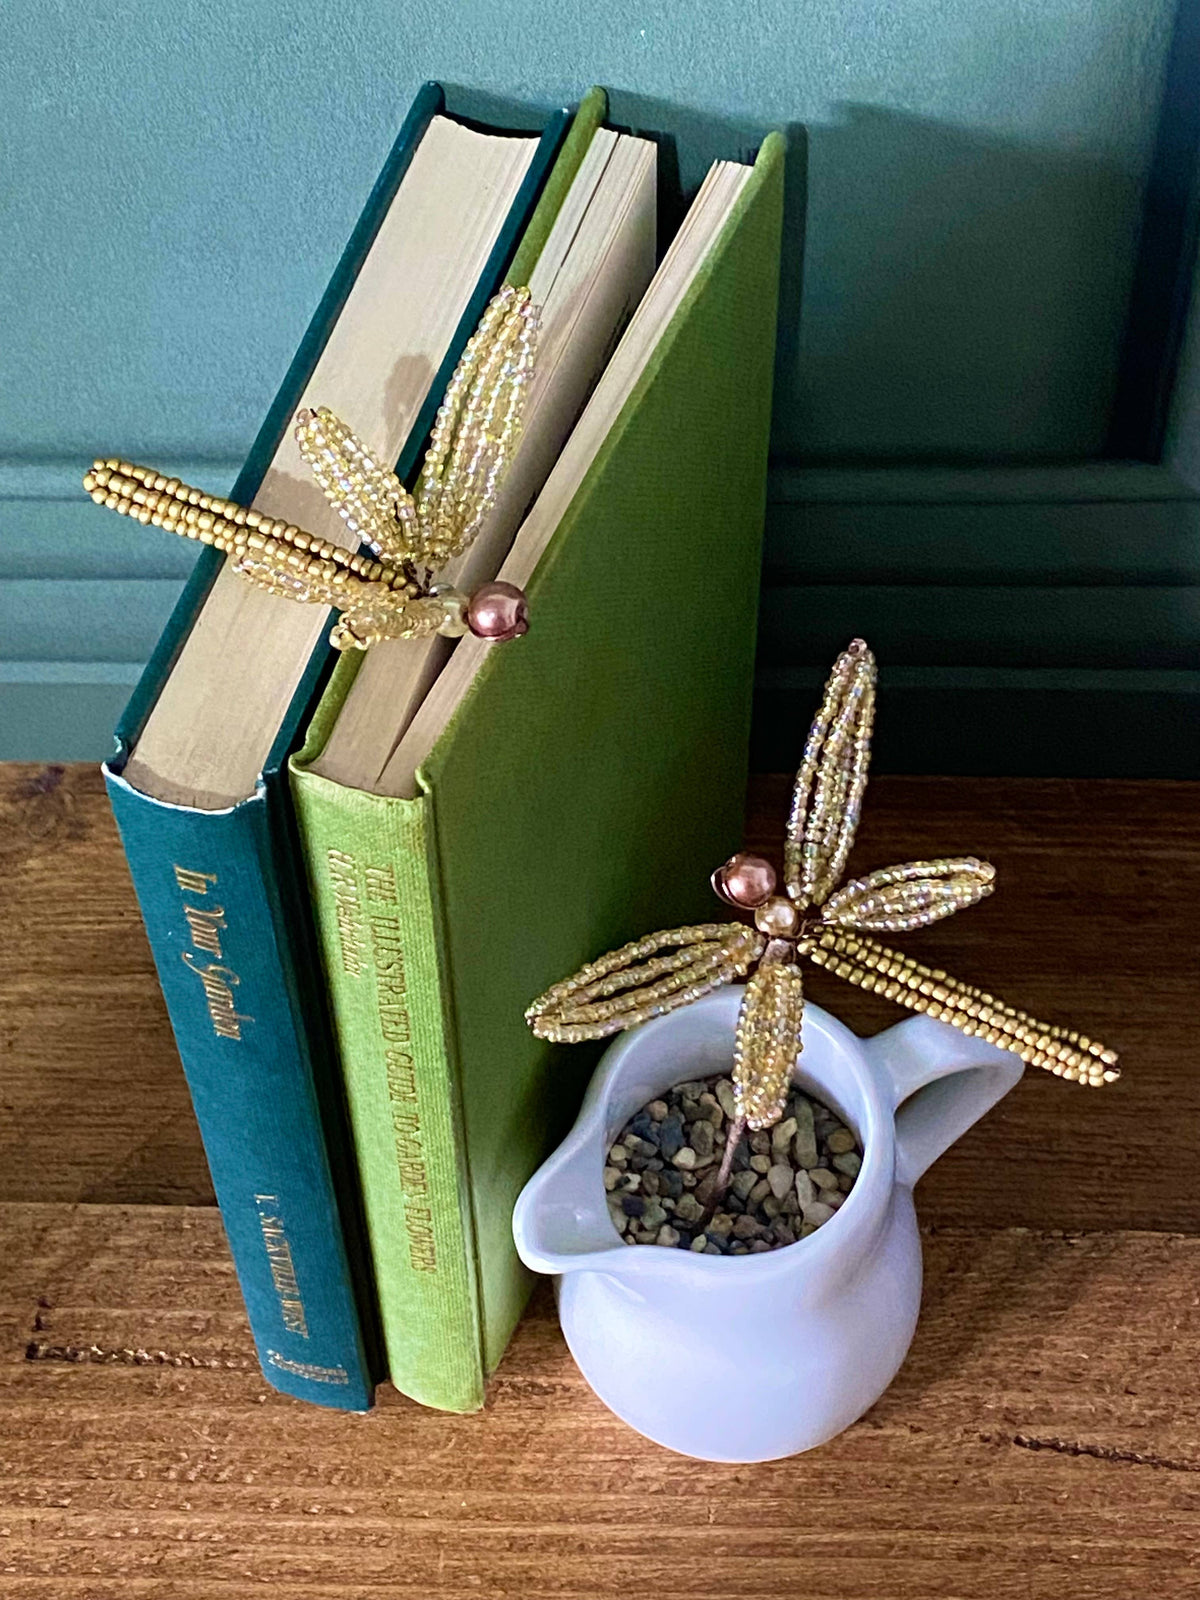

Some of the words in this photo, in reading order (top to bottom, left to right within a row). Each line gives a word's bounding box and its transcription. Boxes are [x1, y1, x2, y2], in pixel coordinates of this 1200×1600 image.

[174, 863, 217, 895] In
[365, 862, 397, 906] THE
[183, 903, 228, 960] Your
[182, 951, 256, 1041] Garden
[371, 914, 411, 1043] ILLUSTRATED
[385, 1050, 418, 1104] GUIDE
[392, 1112, 420, 1135] TO
[395, 1137, 429, 1198] GARDEN
[404, 1203, 437, 1274] FLOWERS
